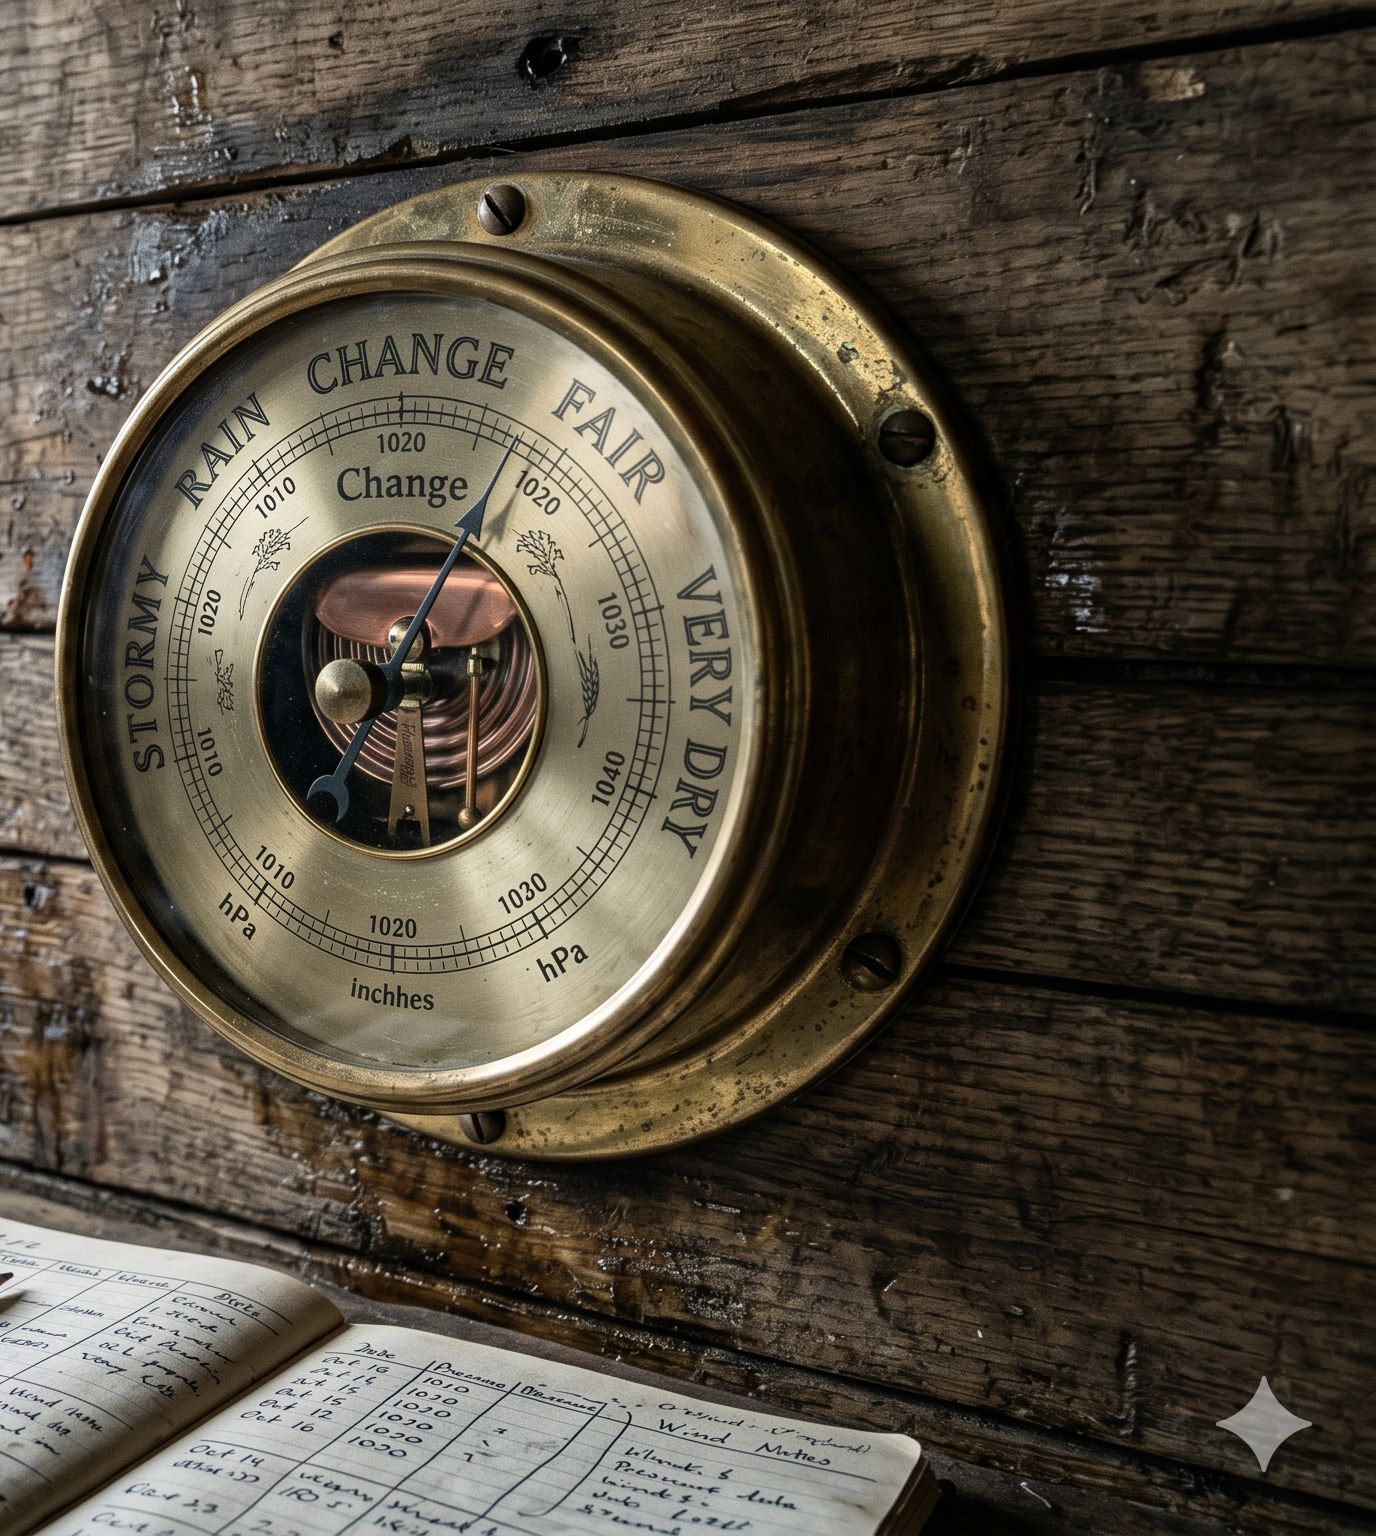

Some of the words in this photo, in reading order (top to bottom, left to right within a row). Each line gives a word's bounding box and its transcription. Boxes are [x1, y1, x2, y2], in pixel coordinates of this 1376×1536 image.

[307, 333, 515, 395] CHANGE
[173, 391, 271, 512] RAIN
[377, 431, 426, 454] 1020
[550, 378, 666, 506] FAIR
[253, 475, 297, 520] 1010
[336, 466, 468, 509] Change
[514, 469, 562, 516] 1020
[197, 589, 222, 636] 1020
[597, 591, 630, 650] 1030
[124, 554, 170, 774] STORMY
[676, 564, 734, 727] VERY
[197, 726, 223, 777] 1010
[591, 750, 626, 808] 1040
[660, 737, 729, 860] DRY
[254, 844, 296, 891] 1010
[218, 892, 258, 941] hPa
[496, 871, 548, 915] 1030
[369, 914, 418, 939] 1020
[536, 943, 590, 983] hPa
[349, 976, 435, 1011] inchhes
[240, 1410, 284, 1425] Oct
[291, 1420, 315, 1434] 16
[658, 1417, 734, 1446] Wind
[189, 1443, 236, 1460] Oct
